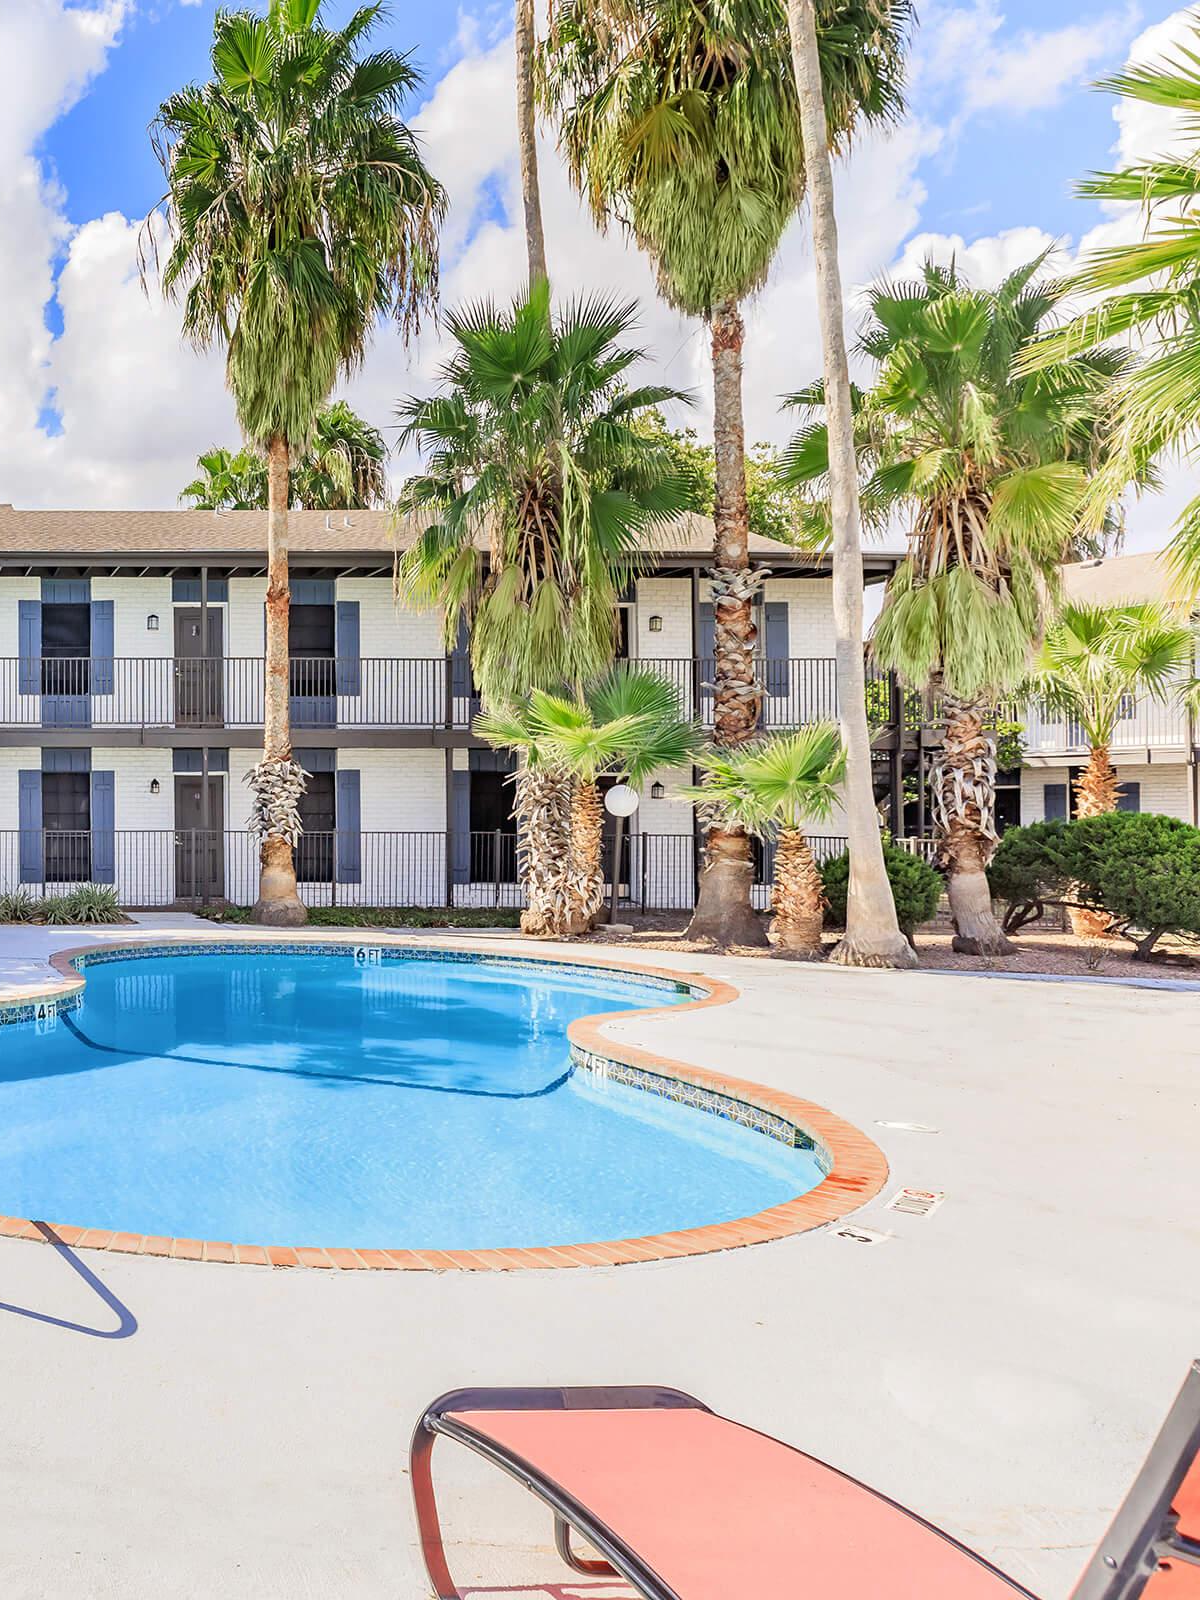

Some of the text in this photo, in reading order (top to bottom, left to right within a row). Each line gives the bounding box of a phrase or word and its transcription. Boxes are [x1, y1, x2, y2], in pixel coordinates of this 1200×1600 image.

[356, 947, 366, 959] 6
[37, 1003, 56, 1020] 4 FT
[585, 1055, 606, 1076] 4 FT
